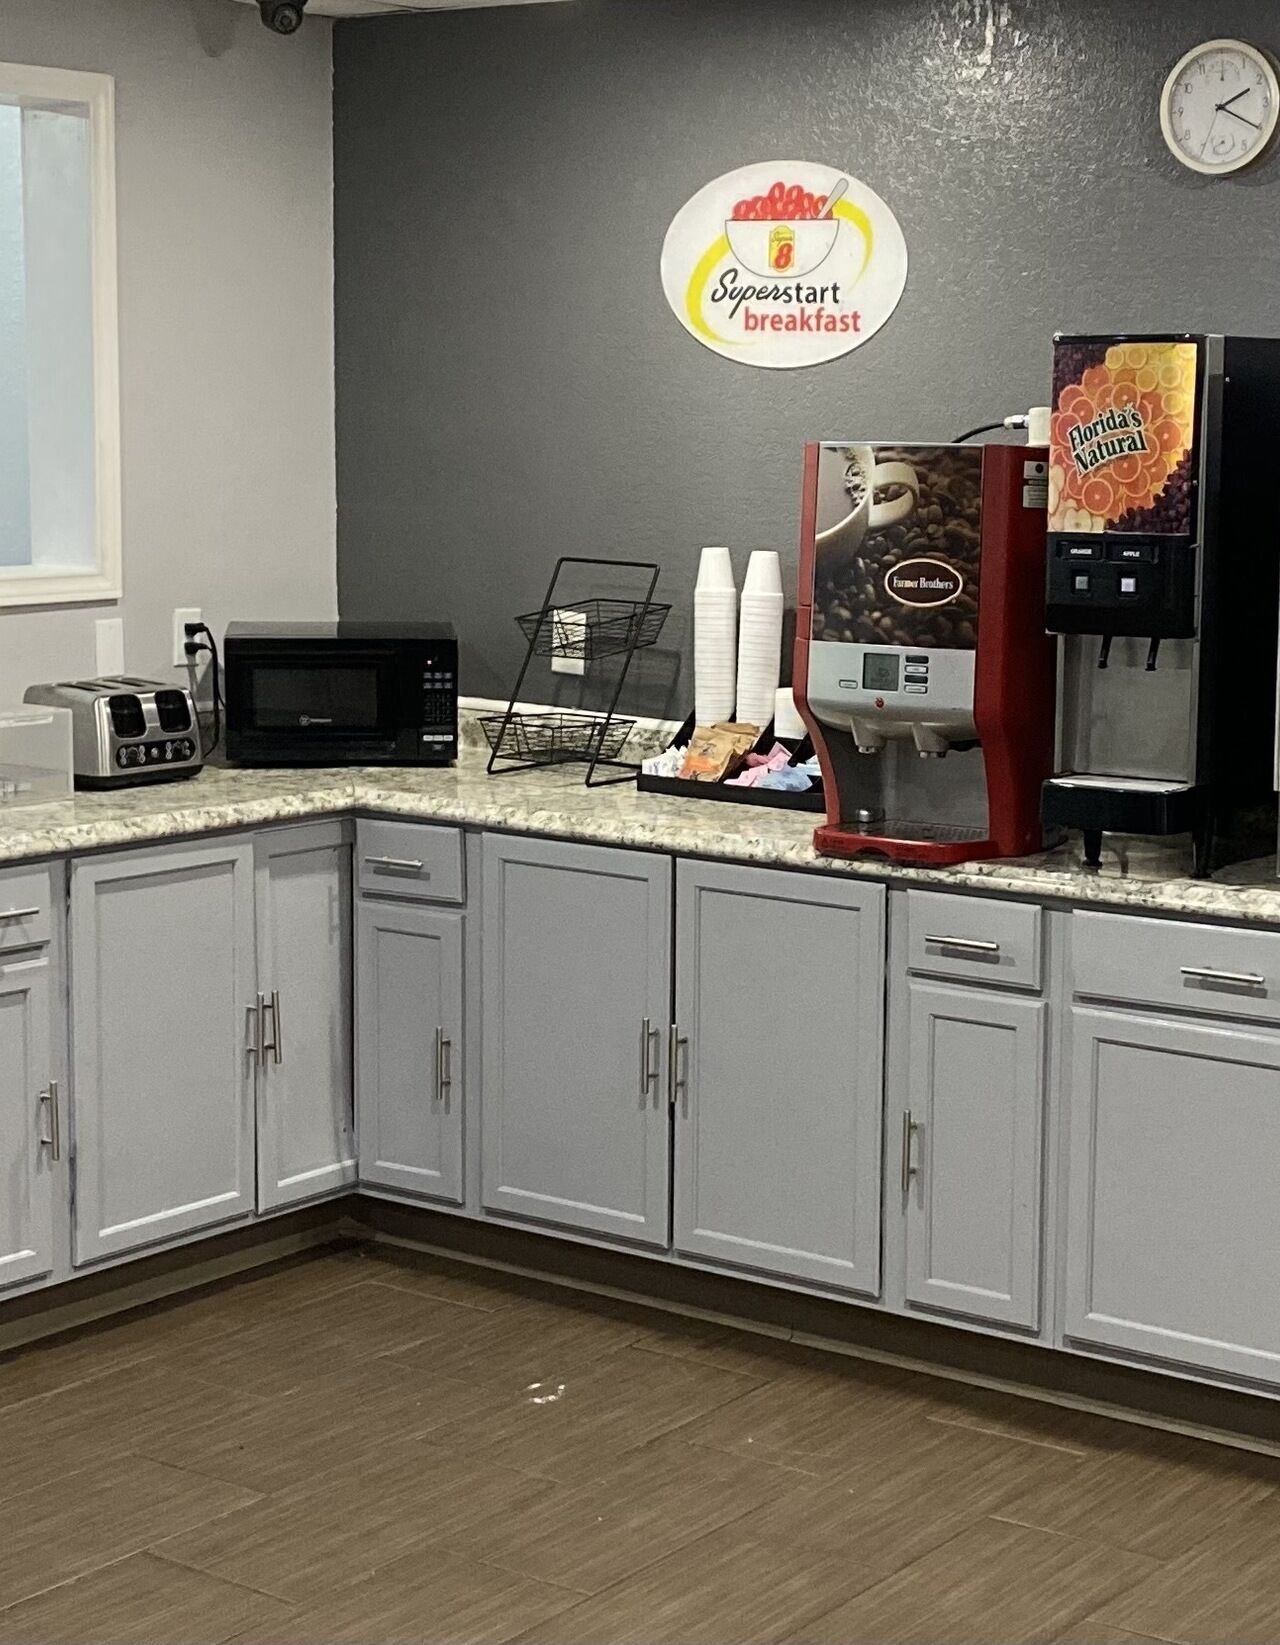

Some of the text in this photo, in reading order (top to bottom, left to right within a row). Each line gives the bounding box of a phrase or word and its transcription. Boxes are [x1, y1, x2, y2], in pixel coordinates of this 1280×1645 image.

[1184, 82, 1193, 95] 10
[1256, 73, 1263, 86] 2
[1177, 106, 1184, 119] 9
[1183, 129, 1191, 141] 8
[775, 242, 793, 268] 8
[711, 268, 840, 319] Superstart
[744, 306, 861, 332] breakfast
[1069, 409, 1142, 451] Florida's
[1074, 431, 1147, 473] Natural
[893, 576, 954, 589] Farmer Brothers
